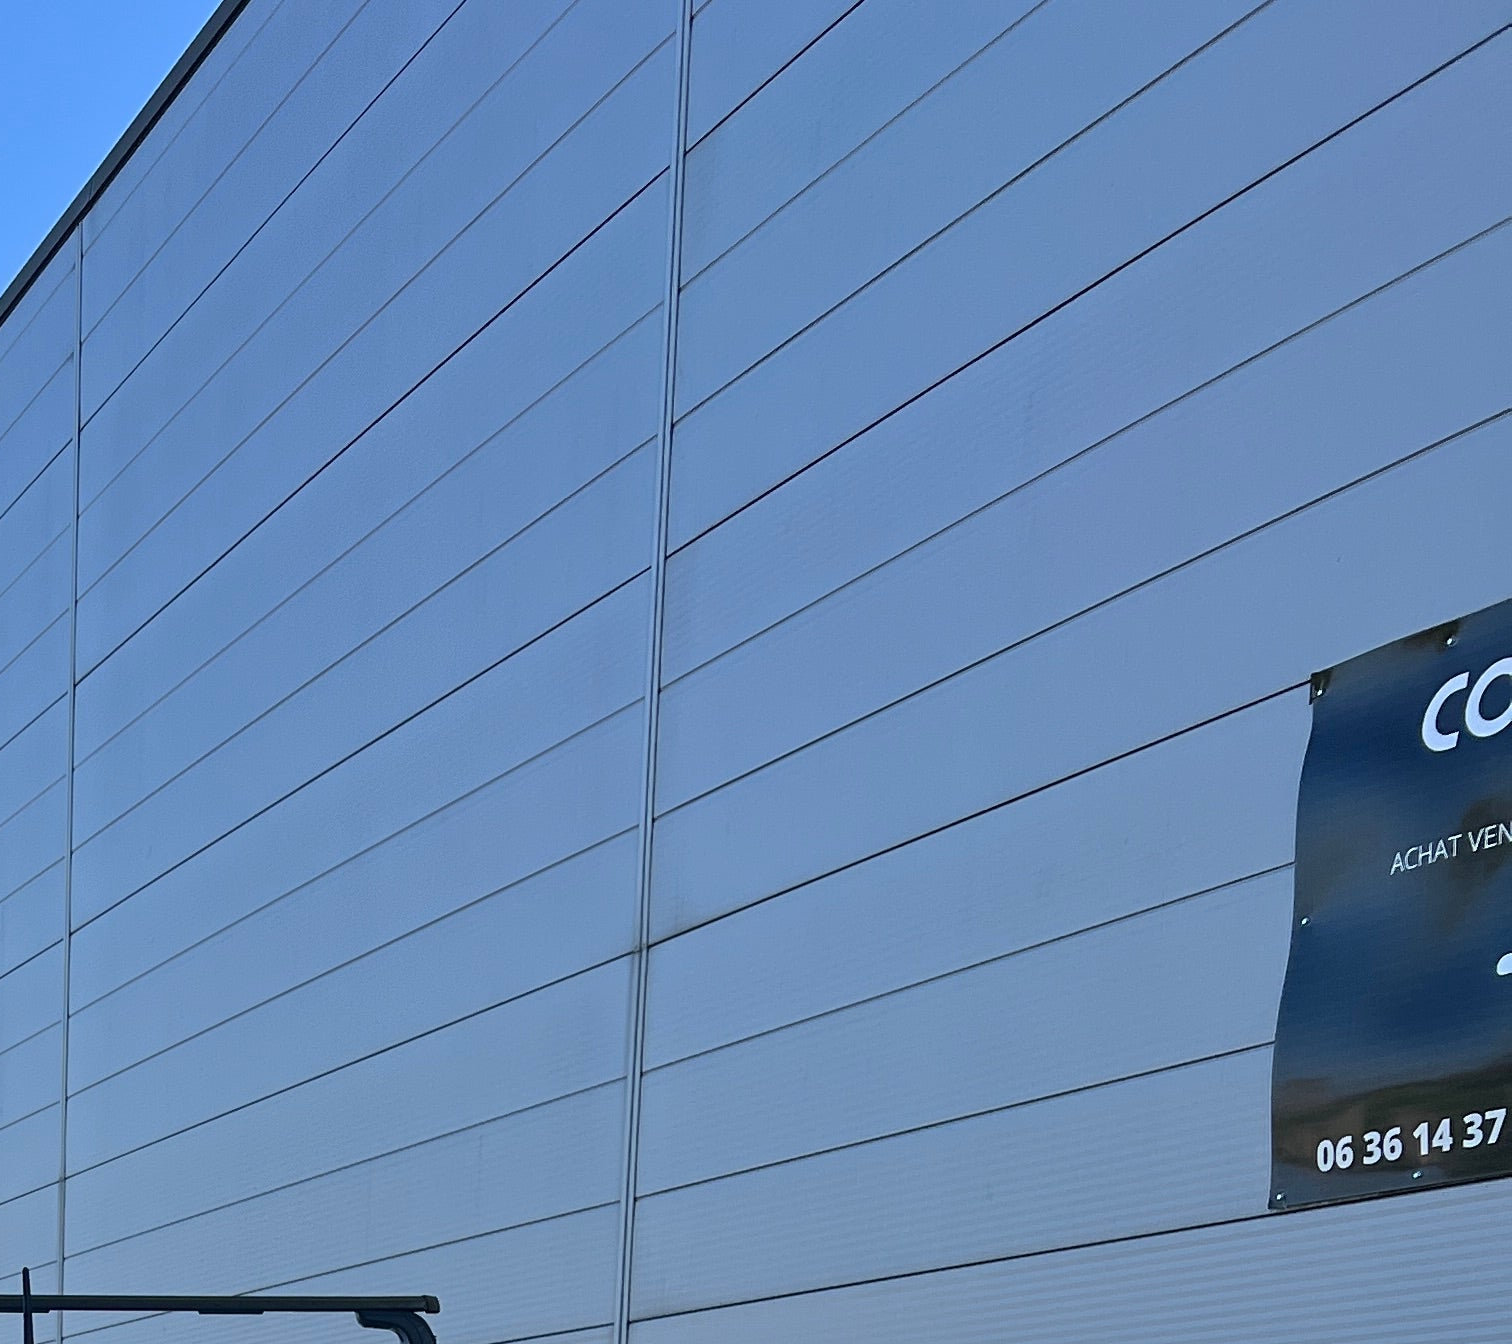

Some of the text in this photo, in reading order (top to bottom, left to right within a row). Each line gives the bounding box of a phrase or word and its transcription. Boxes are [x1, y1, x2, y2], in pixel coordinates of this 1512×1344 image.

[1422, 656, 1512, 752] CO
[1390, 820, 1512, 876] ACHAT VEN
[1316, 1107, 1507, 1173] 06 36 14 37
